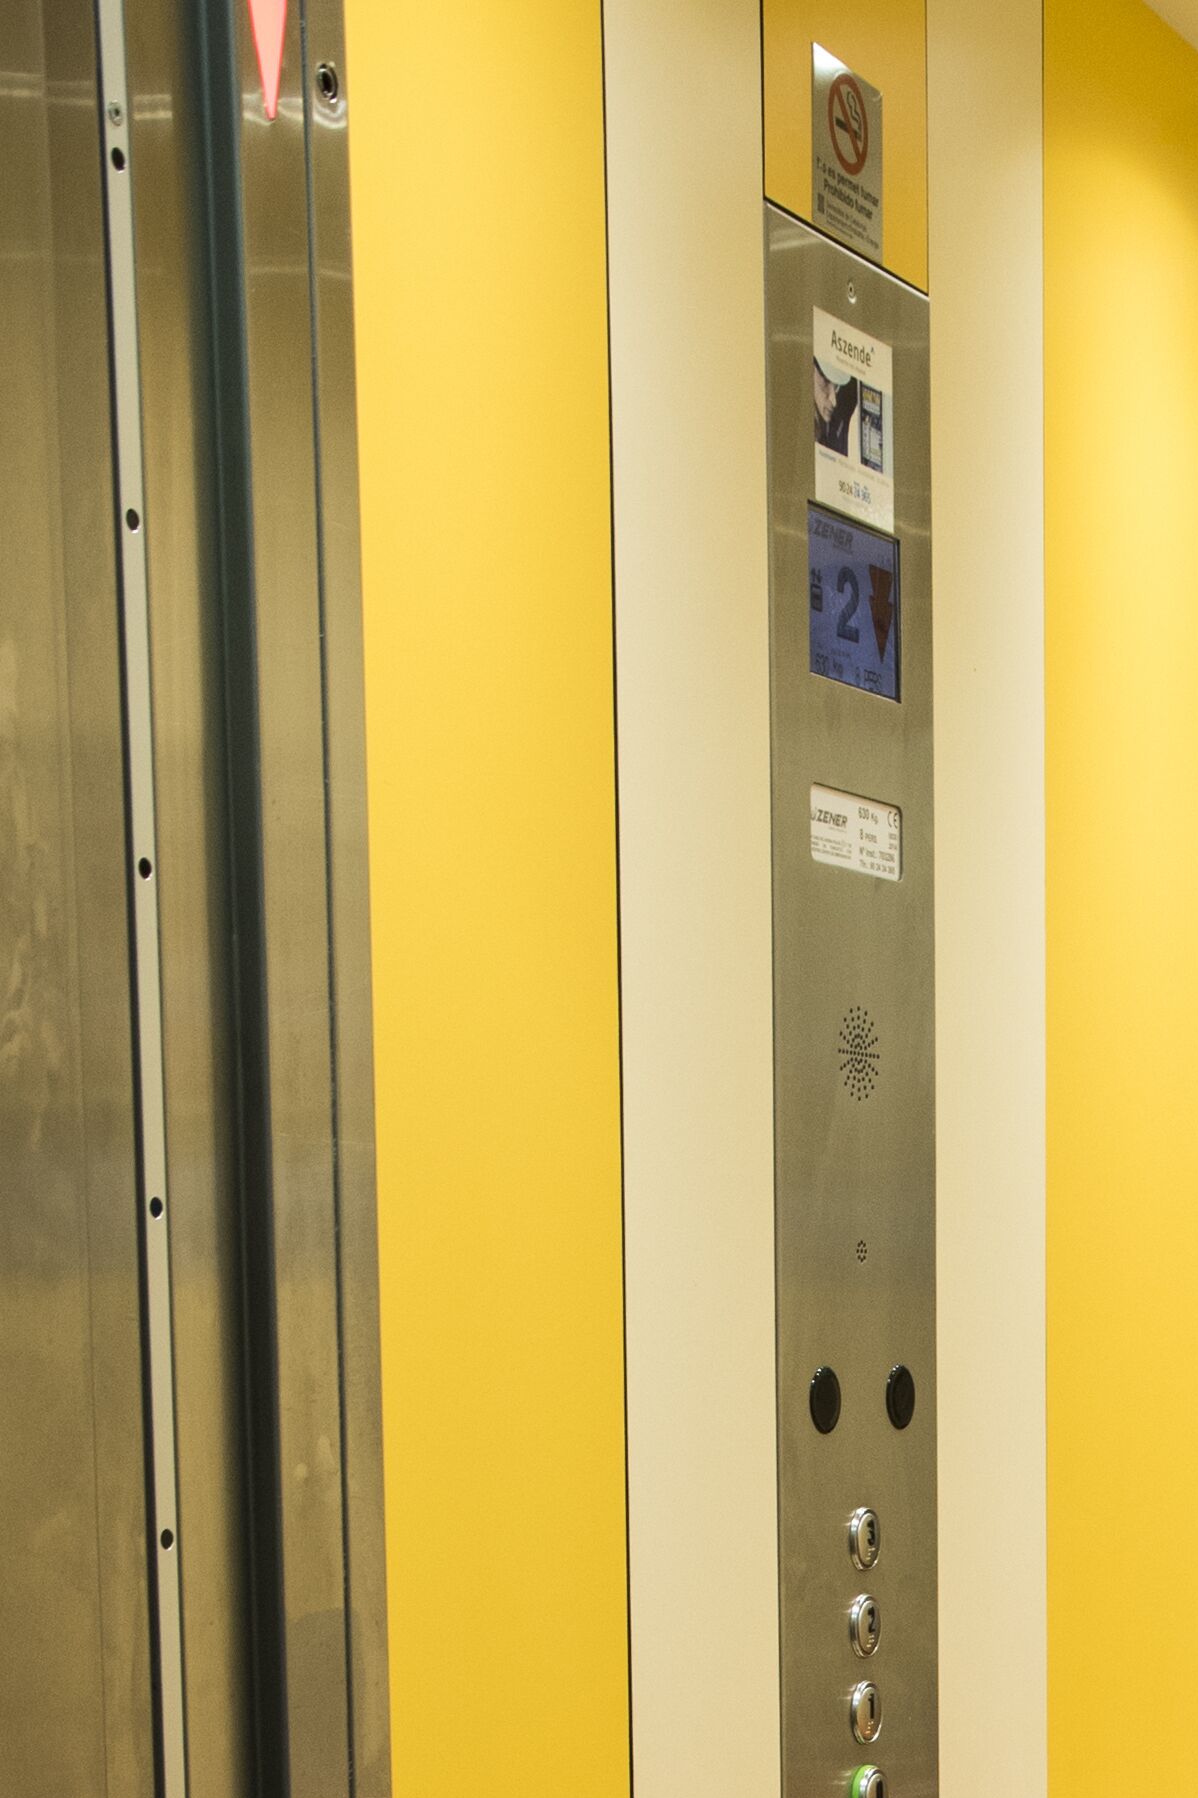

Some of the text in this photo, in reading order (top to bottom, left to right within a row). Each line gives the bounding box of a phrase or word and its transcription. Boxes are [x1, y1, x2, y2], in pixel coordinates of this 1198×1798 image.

[824, 178, 854, 208] Prohibido
[855, 199, 872, 220] fumar
[861, 186, 878, 208] fumar
[813, 519, 854, 547] ZENER
[837, 566, 859, 644] 2
[816, 808, 848, 828] ZENER
[867, 1519, 875, 1546] 3
[867, 1607, 875, 1634] 2
[868, 1693, 875, 1720] 1
